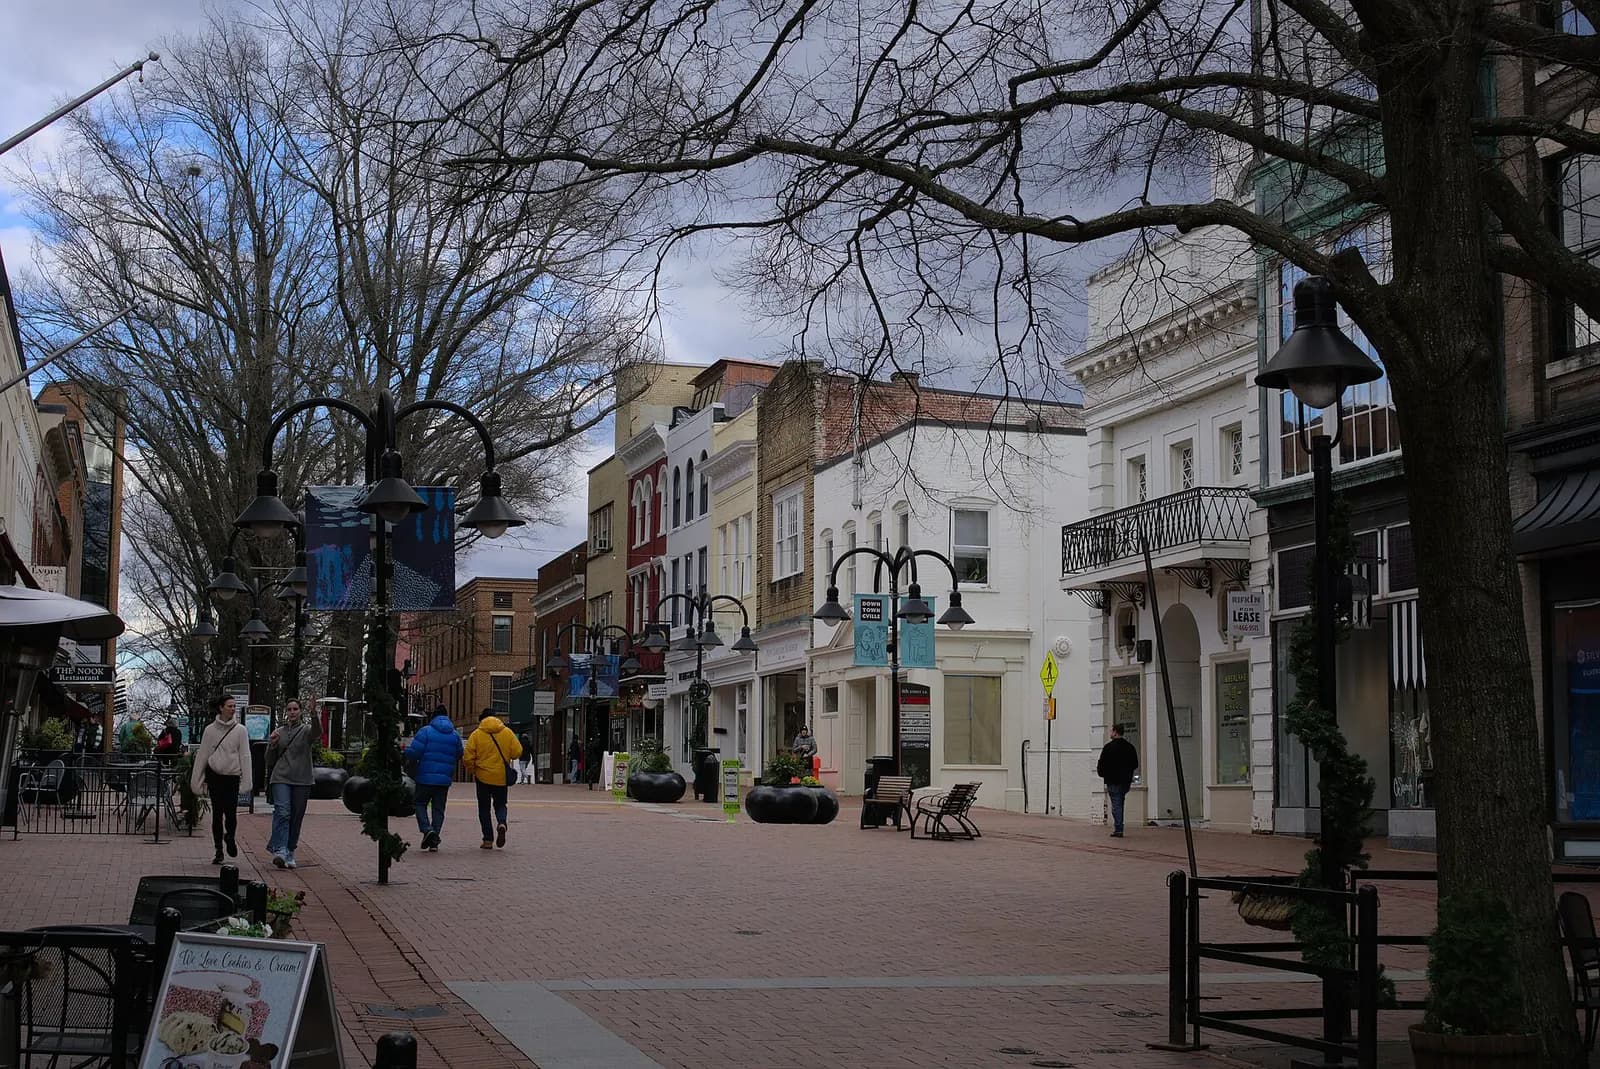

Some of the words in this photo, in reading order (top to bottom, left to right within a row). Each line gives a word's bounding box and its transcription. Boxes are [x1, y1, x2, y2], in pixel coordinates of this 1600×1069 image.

[1233, 611, 1260, 622] LEASE
[77, 667, 104, 675] NOOK
[179, 949, 194, 966] We
[199, 950, 217, 968] Love
[222, 951, 252, 969] Cookies
[255, 958, 265, 970] &
[270, 954, 301, 972] Cream!
